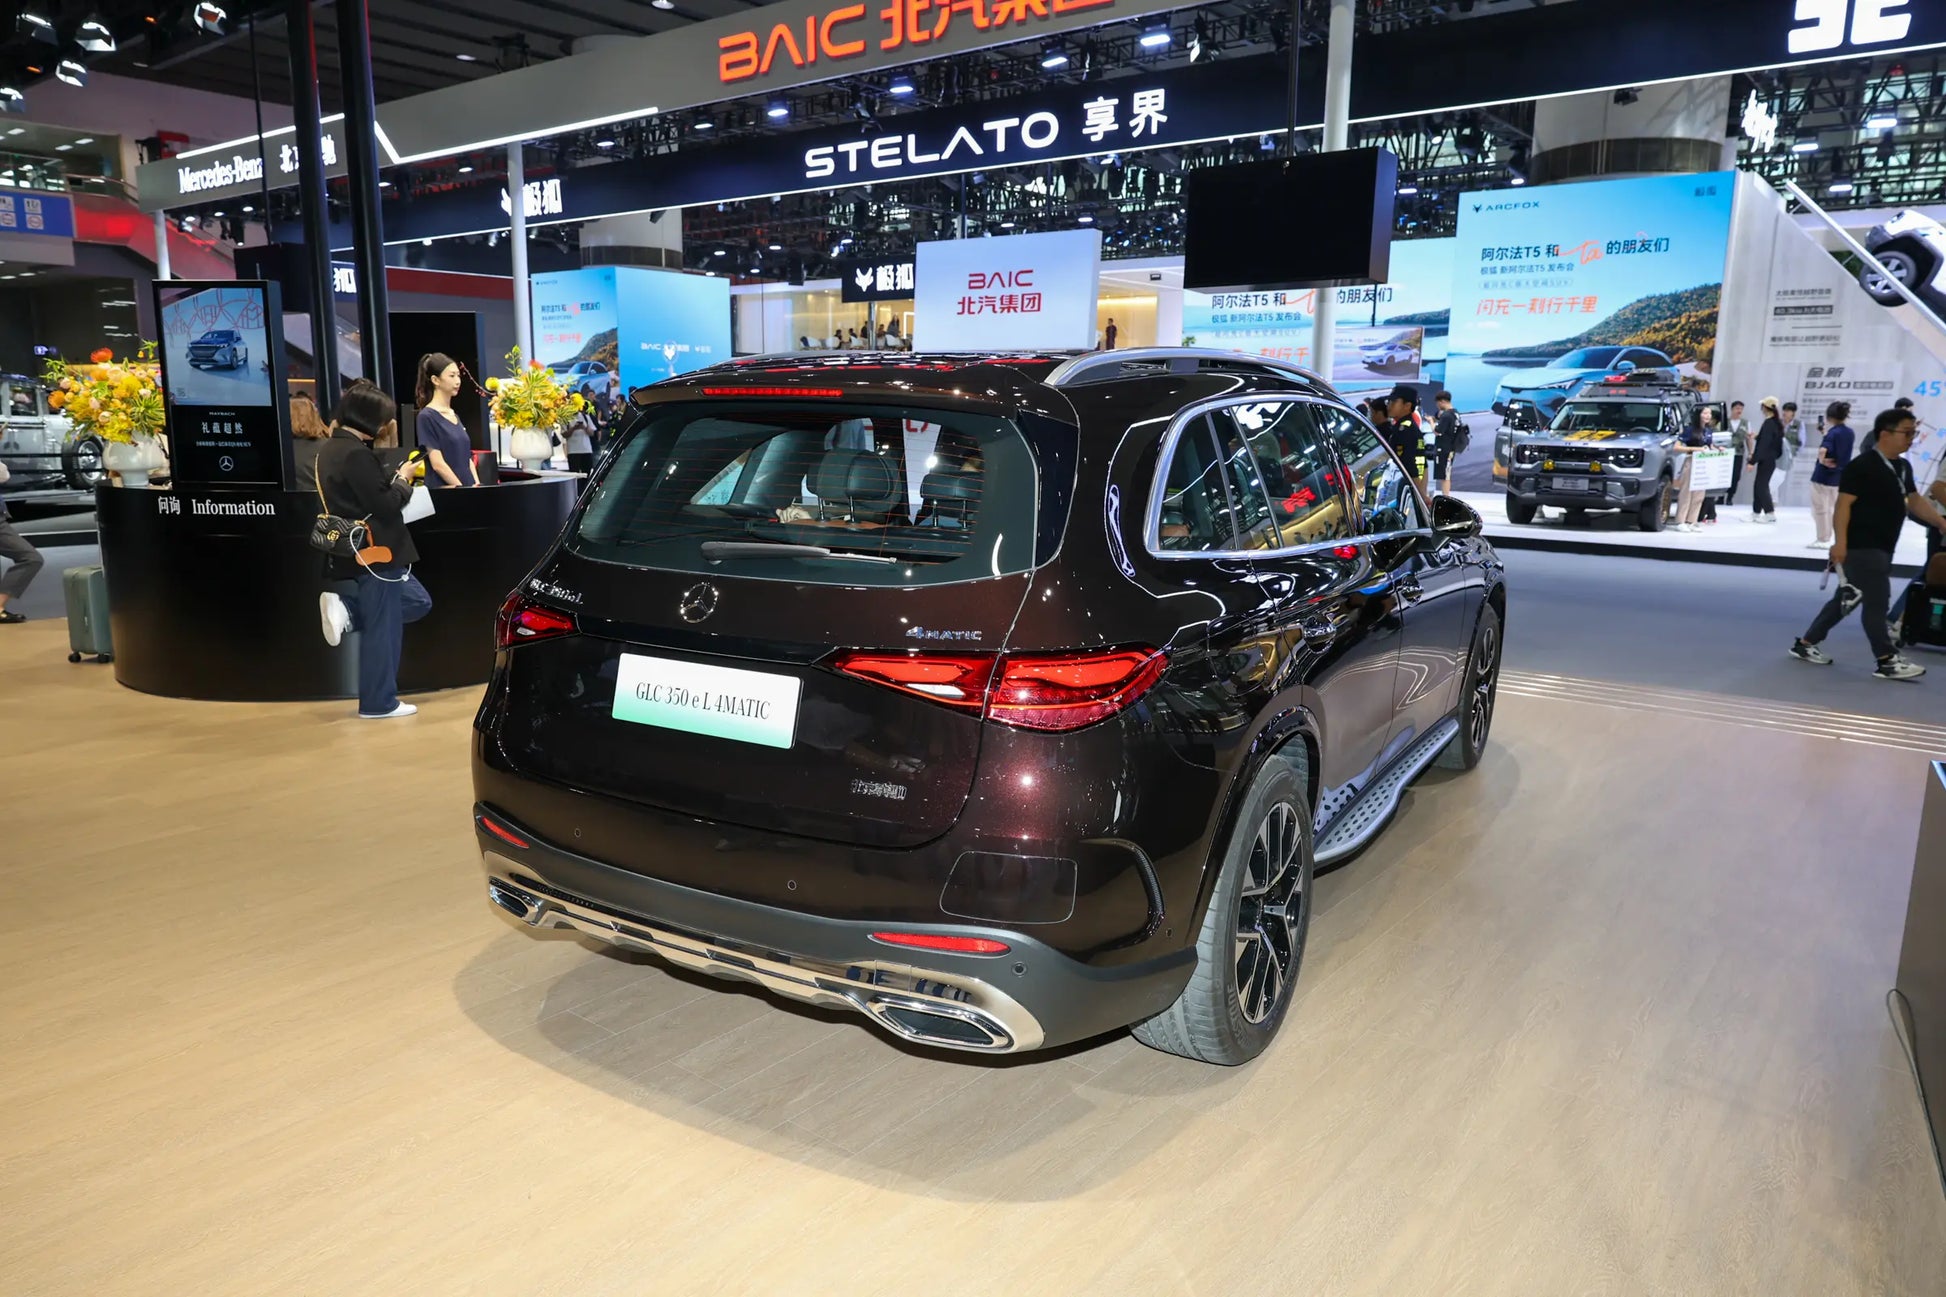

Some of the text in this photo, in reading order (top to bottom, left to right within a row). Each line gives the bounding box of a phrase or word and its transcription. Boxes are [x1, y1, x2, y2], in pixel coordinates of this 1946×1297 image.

[879, 0, 1115, 50] 北汽
[718, 3, 866, 83] BAIC
[804, 87, 1168, 179] STELATO 享界
[1486, 201, 1540, 212] ARCFOX
[1480, 244, 1541, 262] 阿尔法T5
[1546, 243, 1560, 258] 和
[1606, 237, 1670, 256] 的朋友们
[968, 269, 1034, 290] BAIC
[957, 292, 1042, 316] 北汽集团
[1212, 294, 1268, 310] 阿尔法T5
[1273, 292, 1287, 307] 和
[1476, 295, 1598, 316] 闪充一刻行千里
[1804, 381, 1851, 389] BJ40
[158, 496, 276, 515] 问询 Information
[905, 626, 983, 641] 4MATIC
[636, 681, 771, 720] GLC 350 e L 4MATIC
